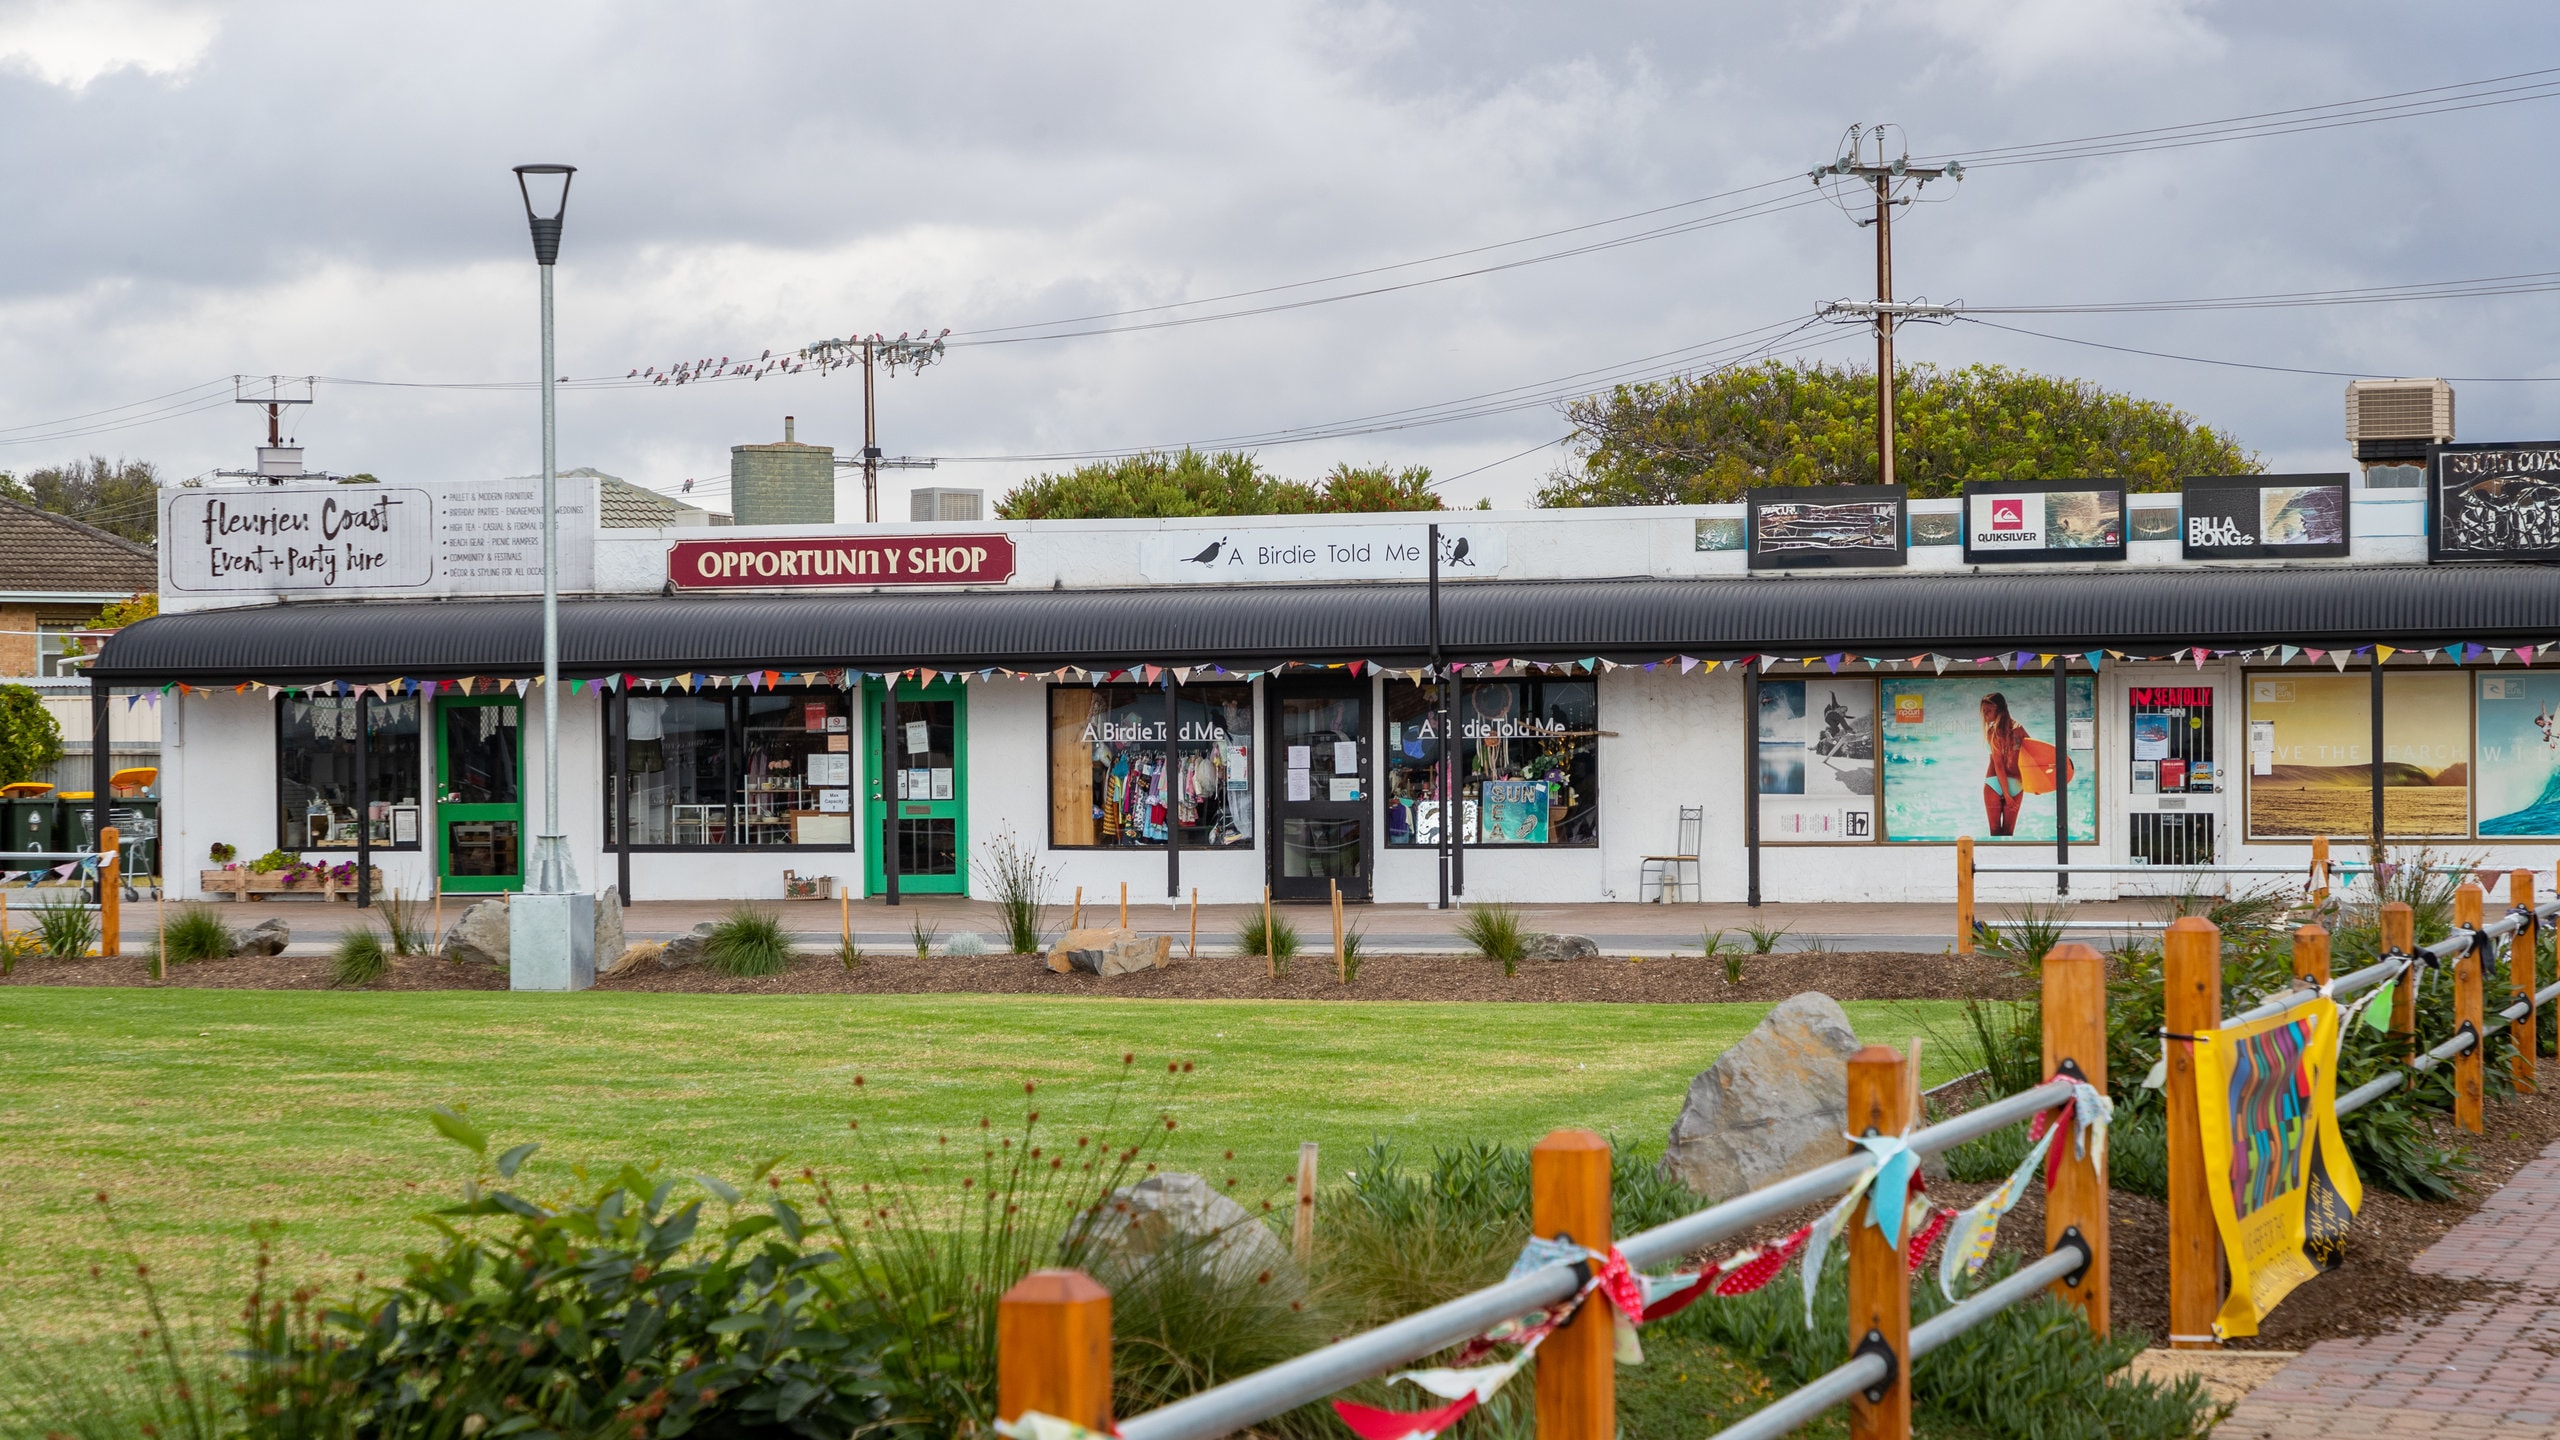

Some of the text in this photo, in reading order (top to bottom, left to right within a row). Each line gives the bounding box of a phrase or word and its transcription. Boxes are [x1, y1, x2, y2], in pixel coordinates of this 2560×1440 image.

[478, 492, 503, 501] MODERN
[504, 491, 535, 500] FURNITURE
[322, 494, 404, 541] Coast
[449, 508, 475, 517] BIRTHDAY
[477, 507, 500, 516] PARTIES
[449, 523, 463, 531] HIGH
[465, 522, 476, 531] TEA
[483, 522, 505, 531] CASUAL
[514, 521, 537, 530] FORMAL
[449, 538, 468, 547] BEACH
[469, 538, 485, 546] GEAR
[491, 537, 510, 546] PICNIC
[511, 537, 539, 545] HAMPERS
[1977, 532, 2037, 543] QUIKSILVER
[2188, 530, 2242, 546] BONG
[449, 553, 485, 562] COMMUNITY
[494, 552, 523, 561] FESTIVALS
[697, 546, 988, 578] OPPORTUNITY SHOP
[1227, 543, 1421, 566] A Birdie Told Me
[288, 543, 336, 586] Party
[346, 543, 388, 571] hire
[477, 568, 500, 577] STYLING
[501, 567, 512, 576] FOR
[514, 567, 525, 576] ALL
[2153, 687, 2212, 706] SEAFOLLY
[1081, 721, 1225, 740] A Birdie Td Me
[1418, 717, 1566, 738] A die Told Me
[2317, 744, 2362, 760] THE
[2388, 743, 2465, 760] EARCH
[1491, 785, 1536, 803] SUN
